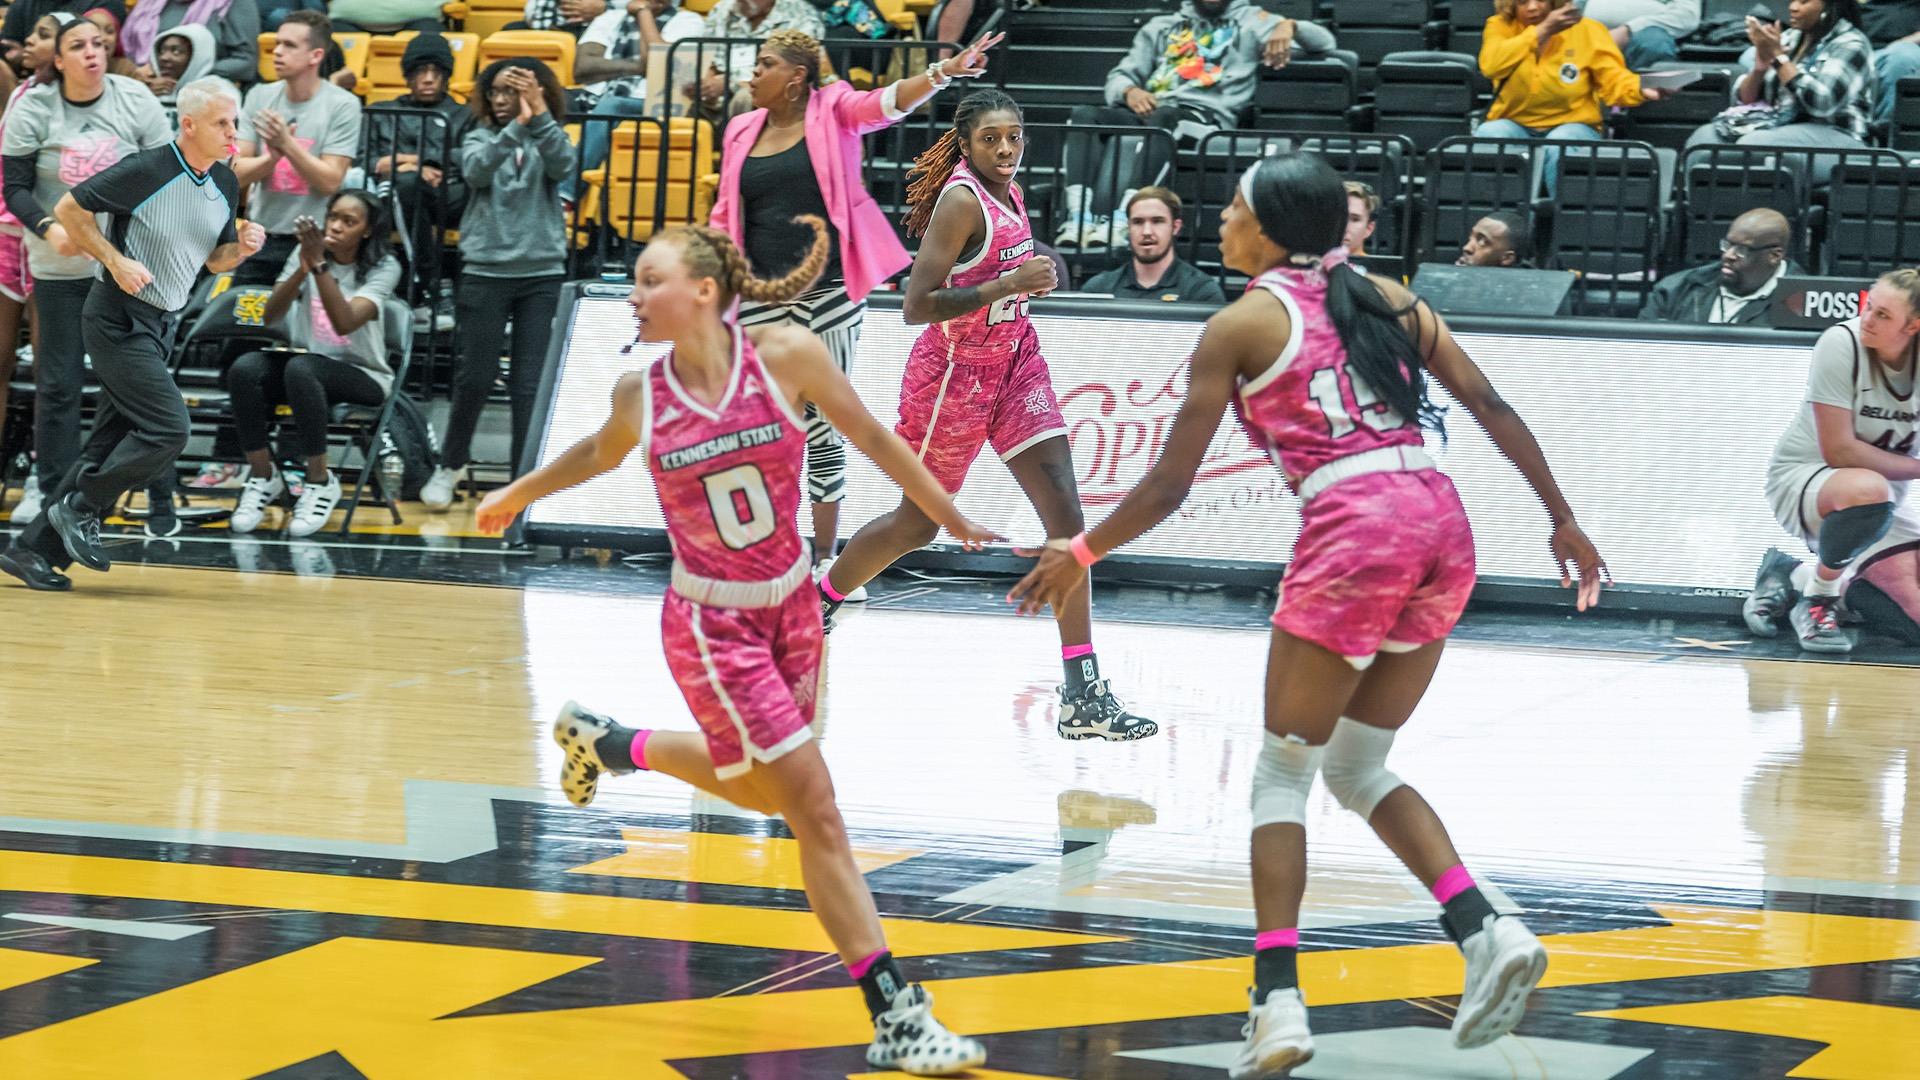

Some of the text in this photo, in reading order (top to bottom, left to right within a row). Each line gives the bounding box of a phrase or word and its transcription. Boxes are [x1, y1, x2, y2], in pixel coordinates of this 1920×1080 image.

[986, 265, 1029, 326] 2
[1804, 291, 1860, 318] POSS
[660, 423, 781, 470] KENNESAW STATE
[700, 463, 776, 550] 0
